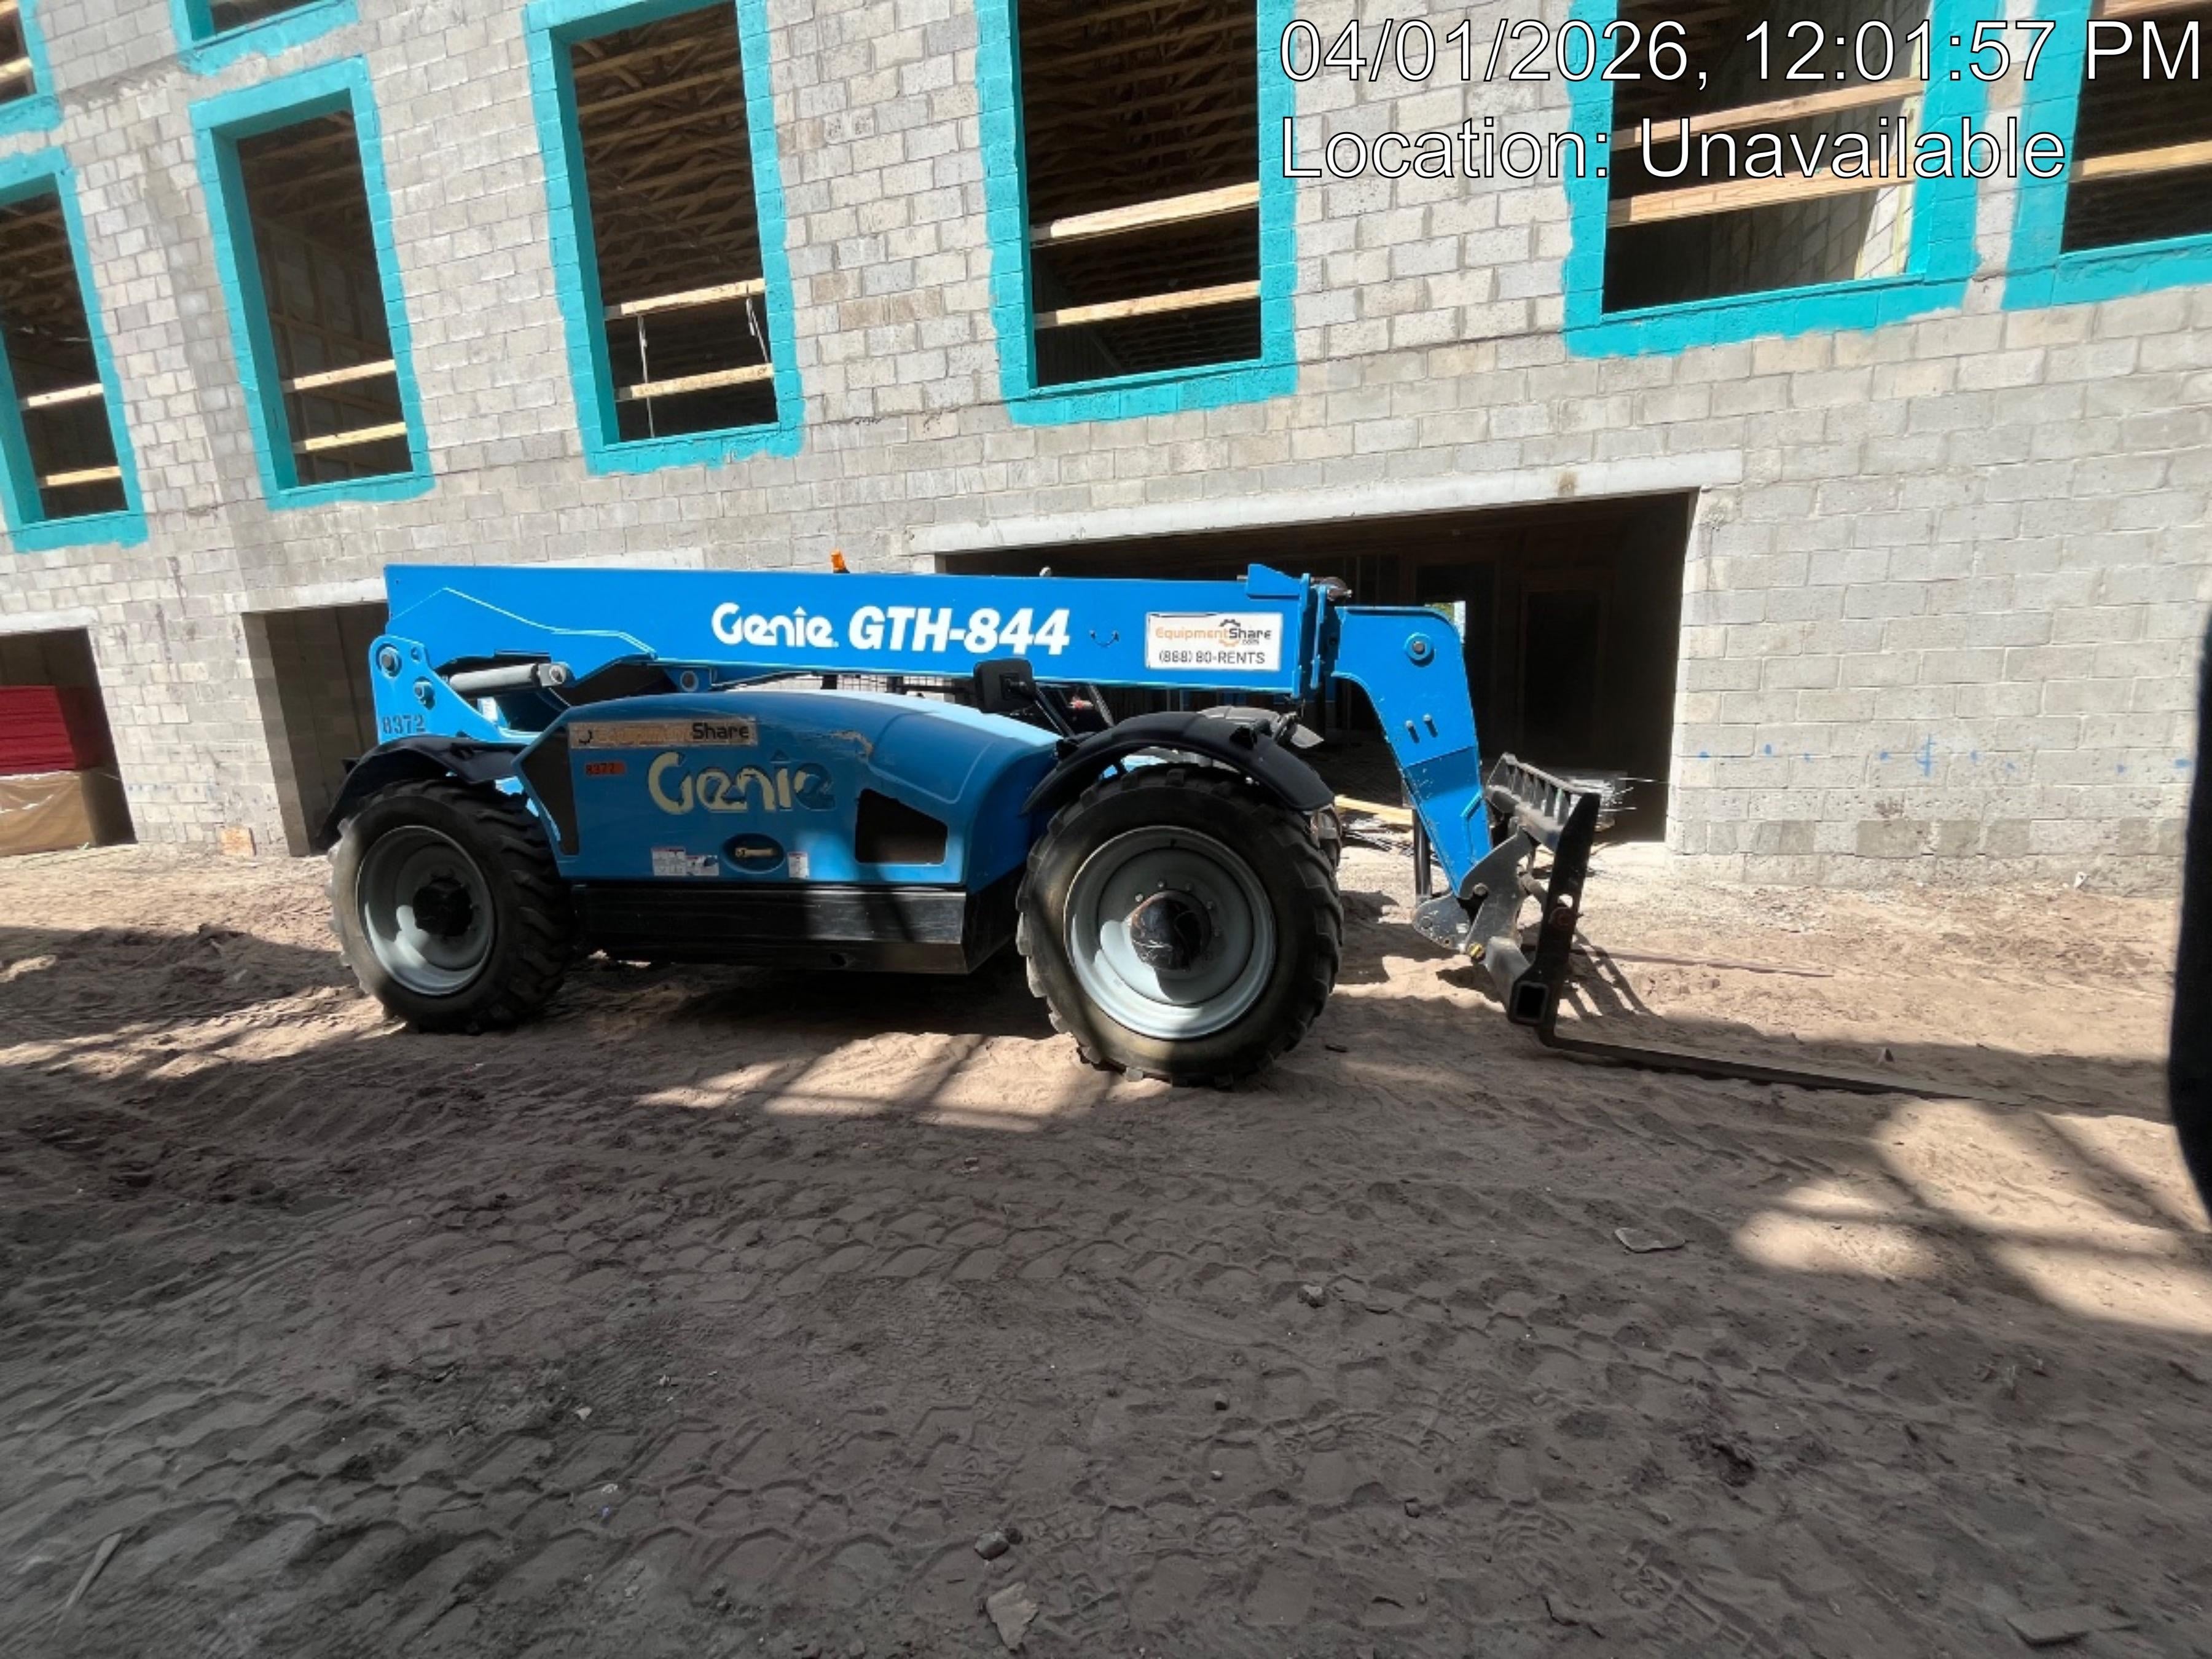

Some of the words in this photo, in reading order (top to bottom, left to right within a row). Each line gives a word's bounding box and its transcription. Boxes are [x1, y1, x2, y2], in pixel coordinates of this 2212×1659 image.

[712, 602, 838, 648] Genie
[849, 605, 1070, 655] GTH-844
[1155, 627, 1272, 641] EquipmentShare
